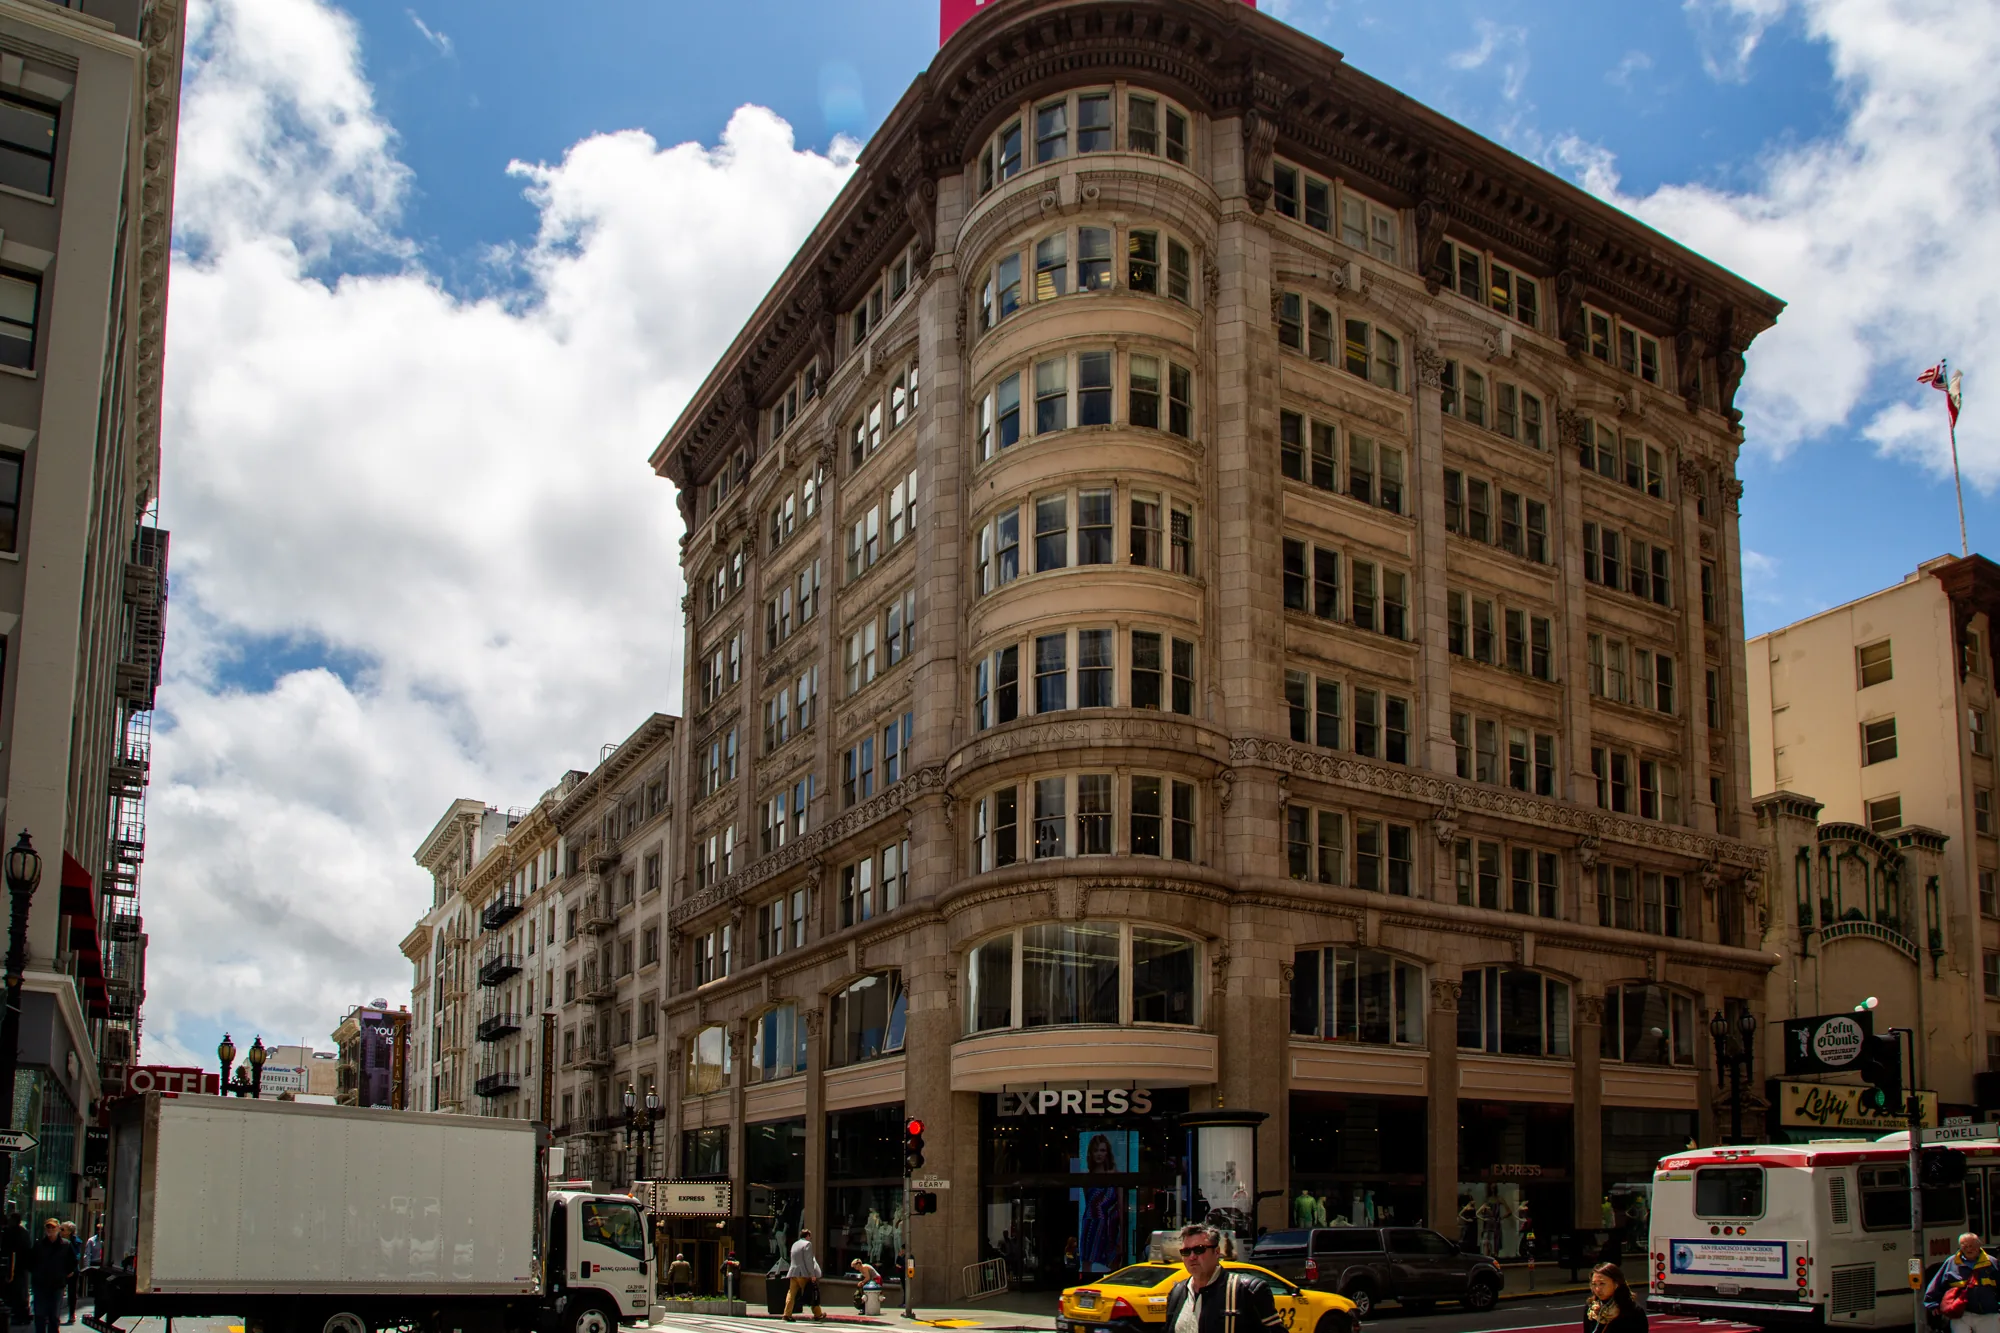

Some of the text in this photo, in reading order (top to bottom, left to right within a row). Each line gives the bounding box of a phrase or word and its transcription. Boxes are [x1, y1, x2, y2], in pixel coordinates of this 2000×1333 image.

[1824, 1021, 1854, 1035] Lefty
[262, 1075, 289, 1083] FOREVER
[997, 1088, 1152, 1117] EXPRESS
[1842, 1118, 1876, 1128] RESTAURANT
[1935, 1127, 1983, 1139] POWELL
[1493, 1163, 1542, 1176] EXPRESS
[1668, 1159, 1690, 1168] 6249
